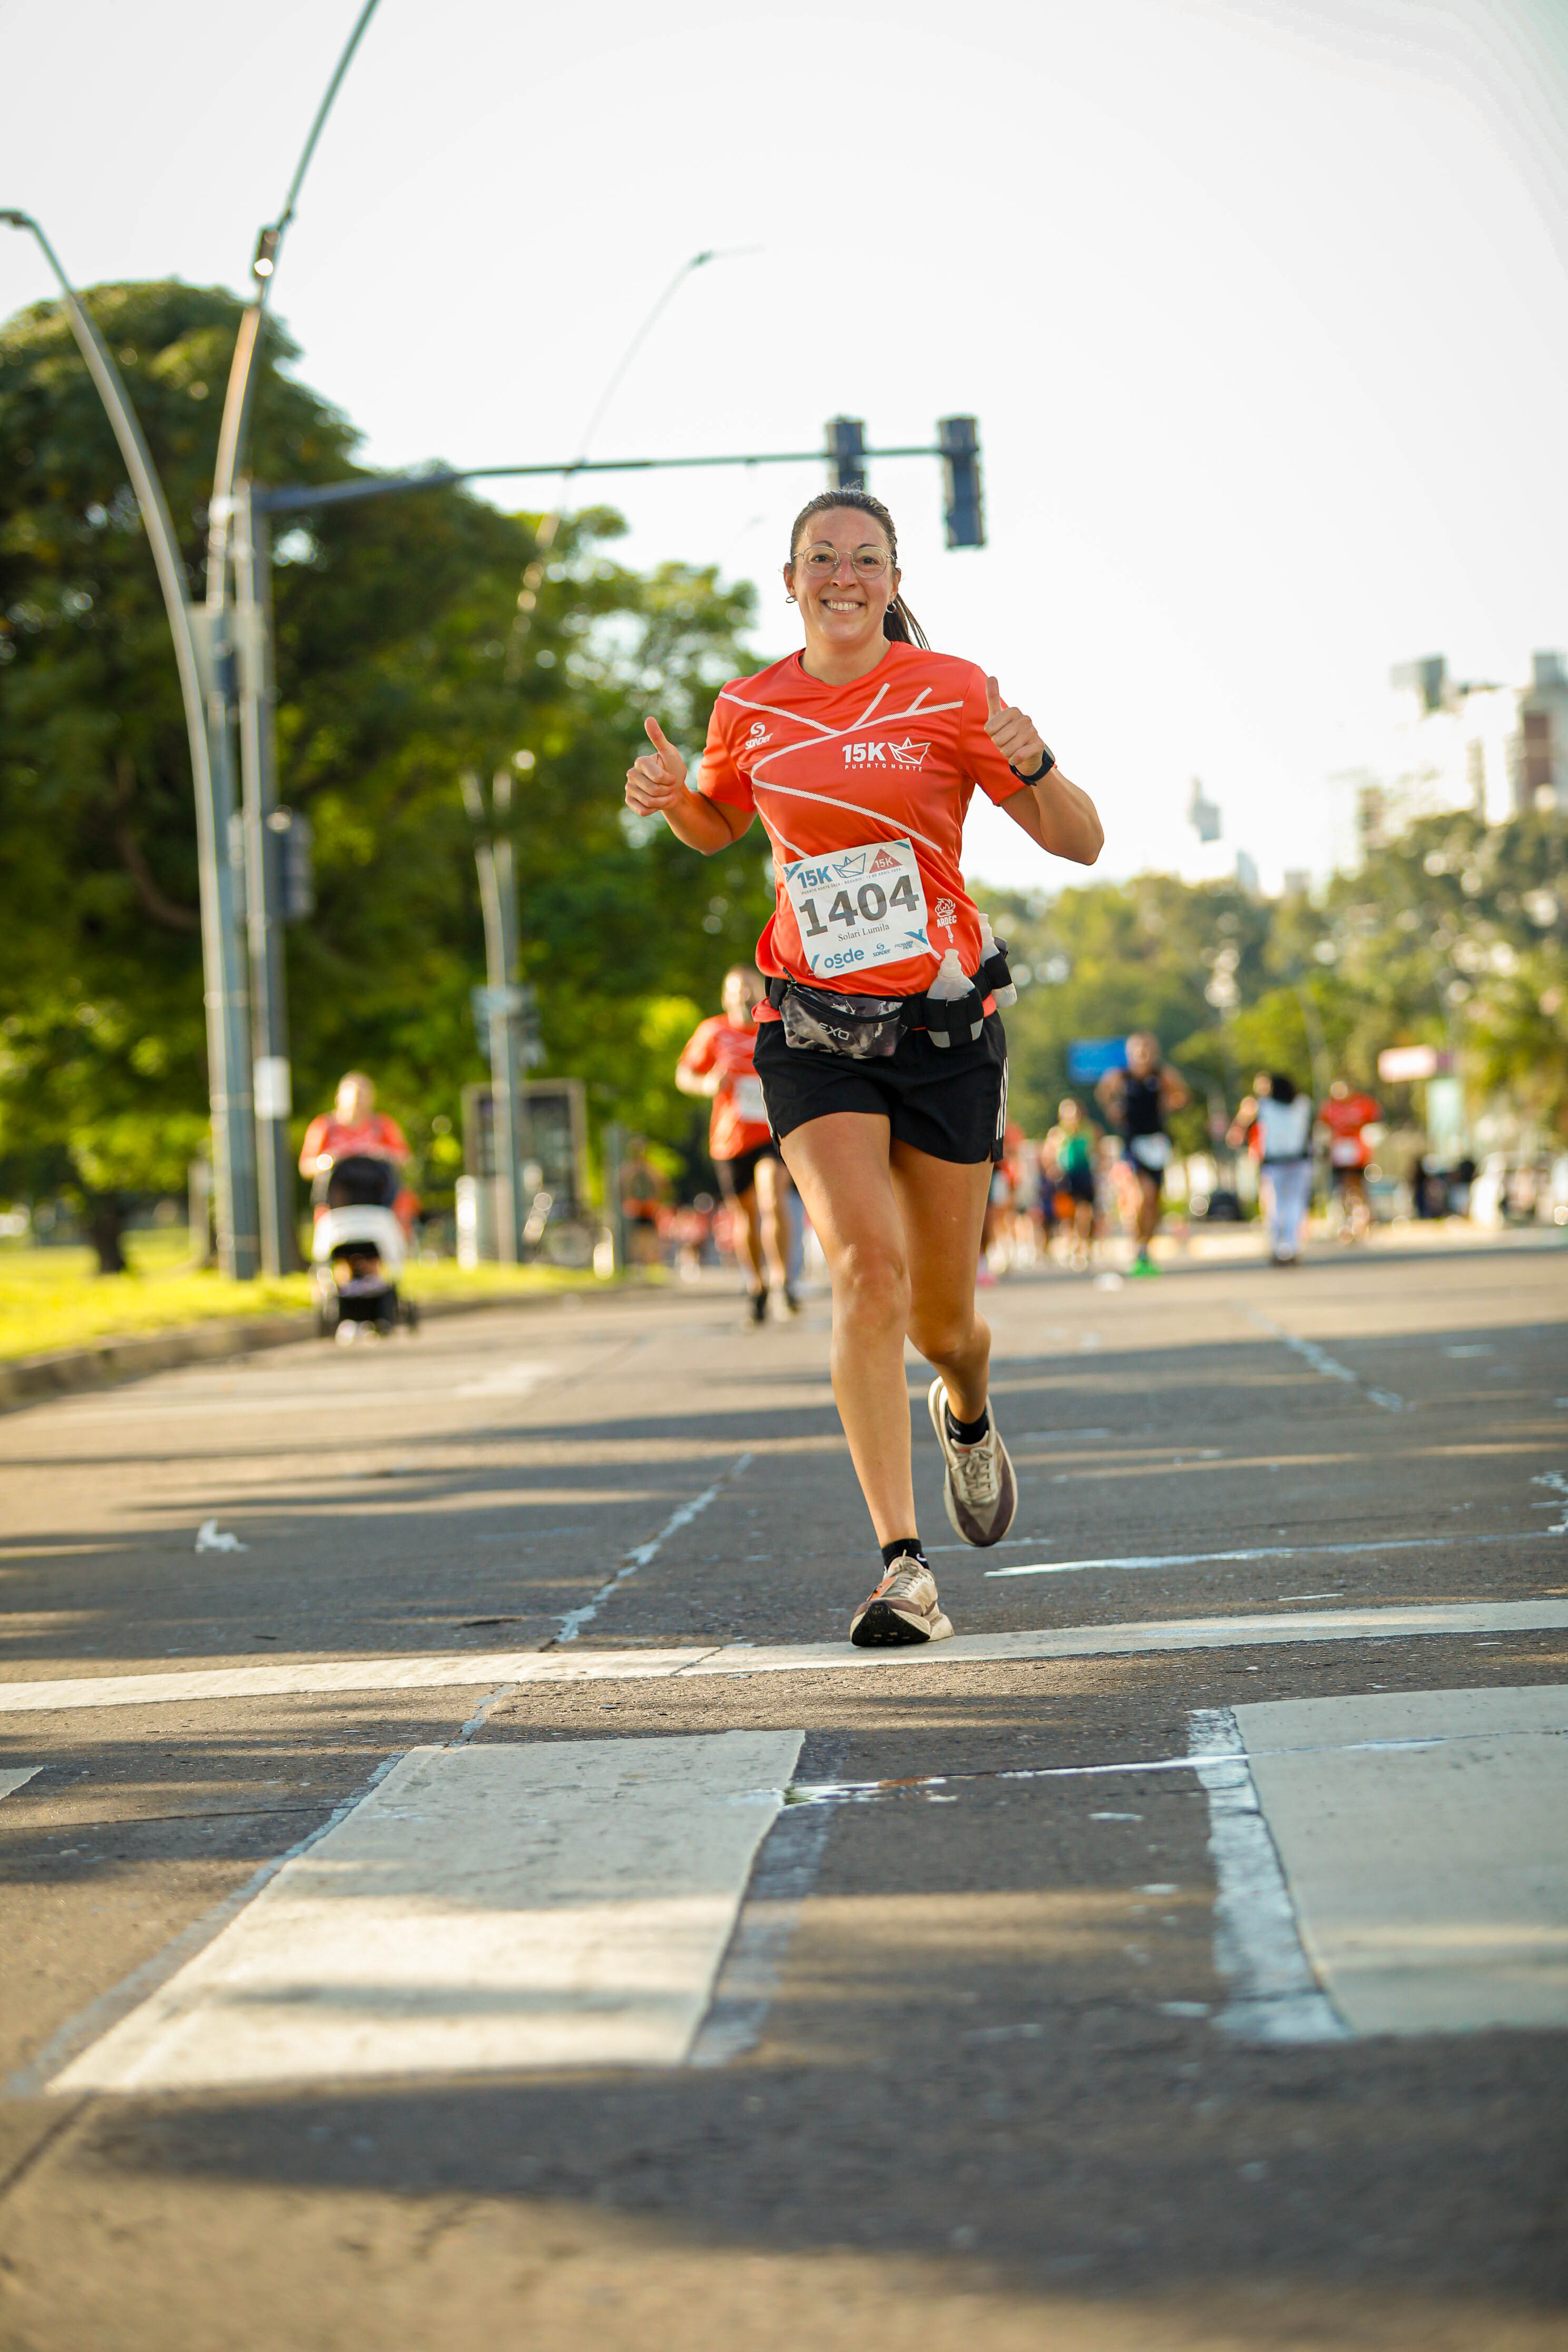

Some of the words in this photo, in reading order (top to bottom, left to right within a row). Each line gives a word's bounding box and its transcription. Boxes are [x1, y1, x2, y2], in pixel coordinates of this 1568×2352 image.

[842, 742, 886, 763] 15K
[875, 857, 893, 869] 15K
[797, 865, 833, 888] 15K
[799, 874, 920, 937] 1404
[937, 915, 957, 928] ARDEC
[838, 929, 860, 942] Solari
[862, 923, 890, 935] Lumila
[824, 948, 865, 969] osde
[818, 1022, 849, 1041] EXO
